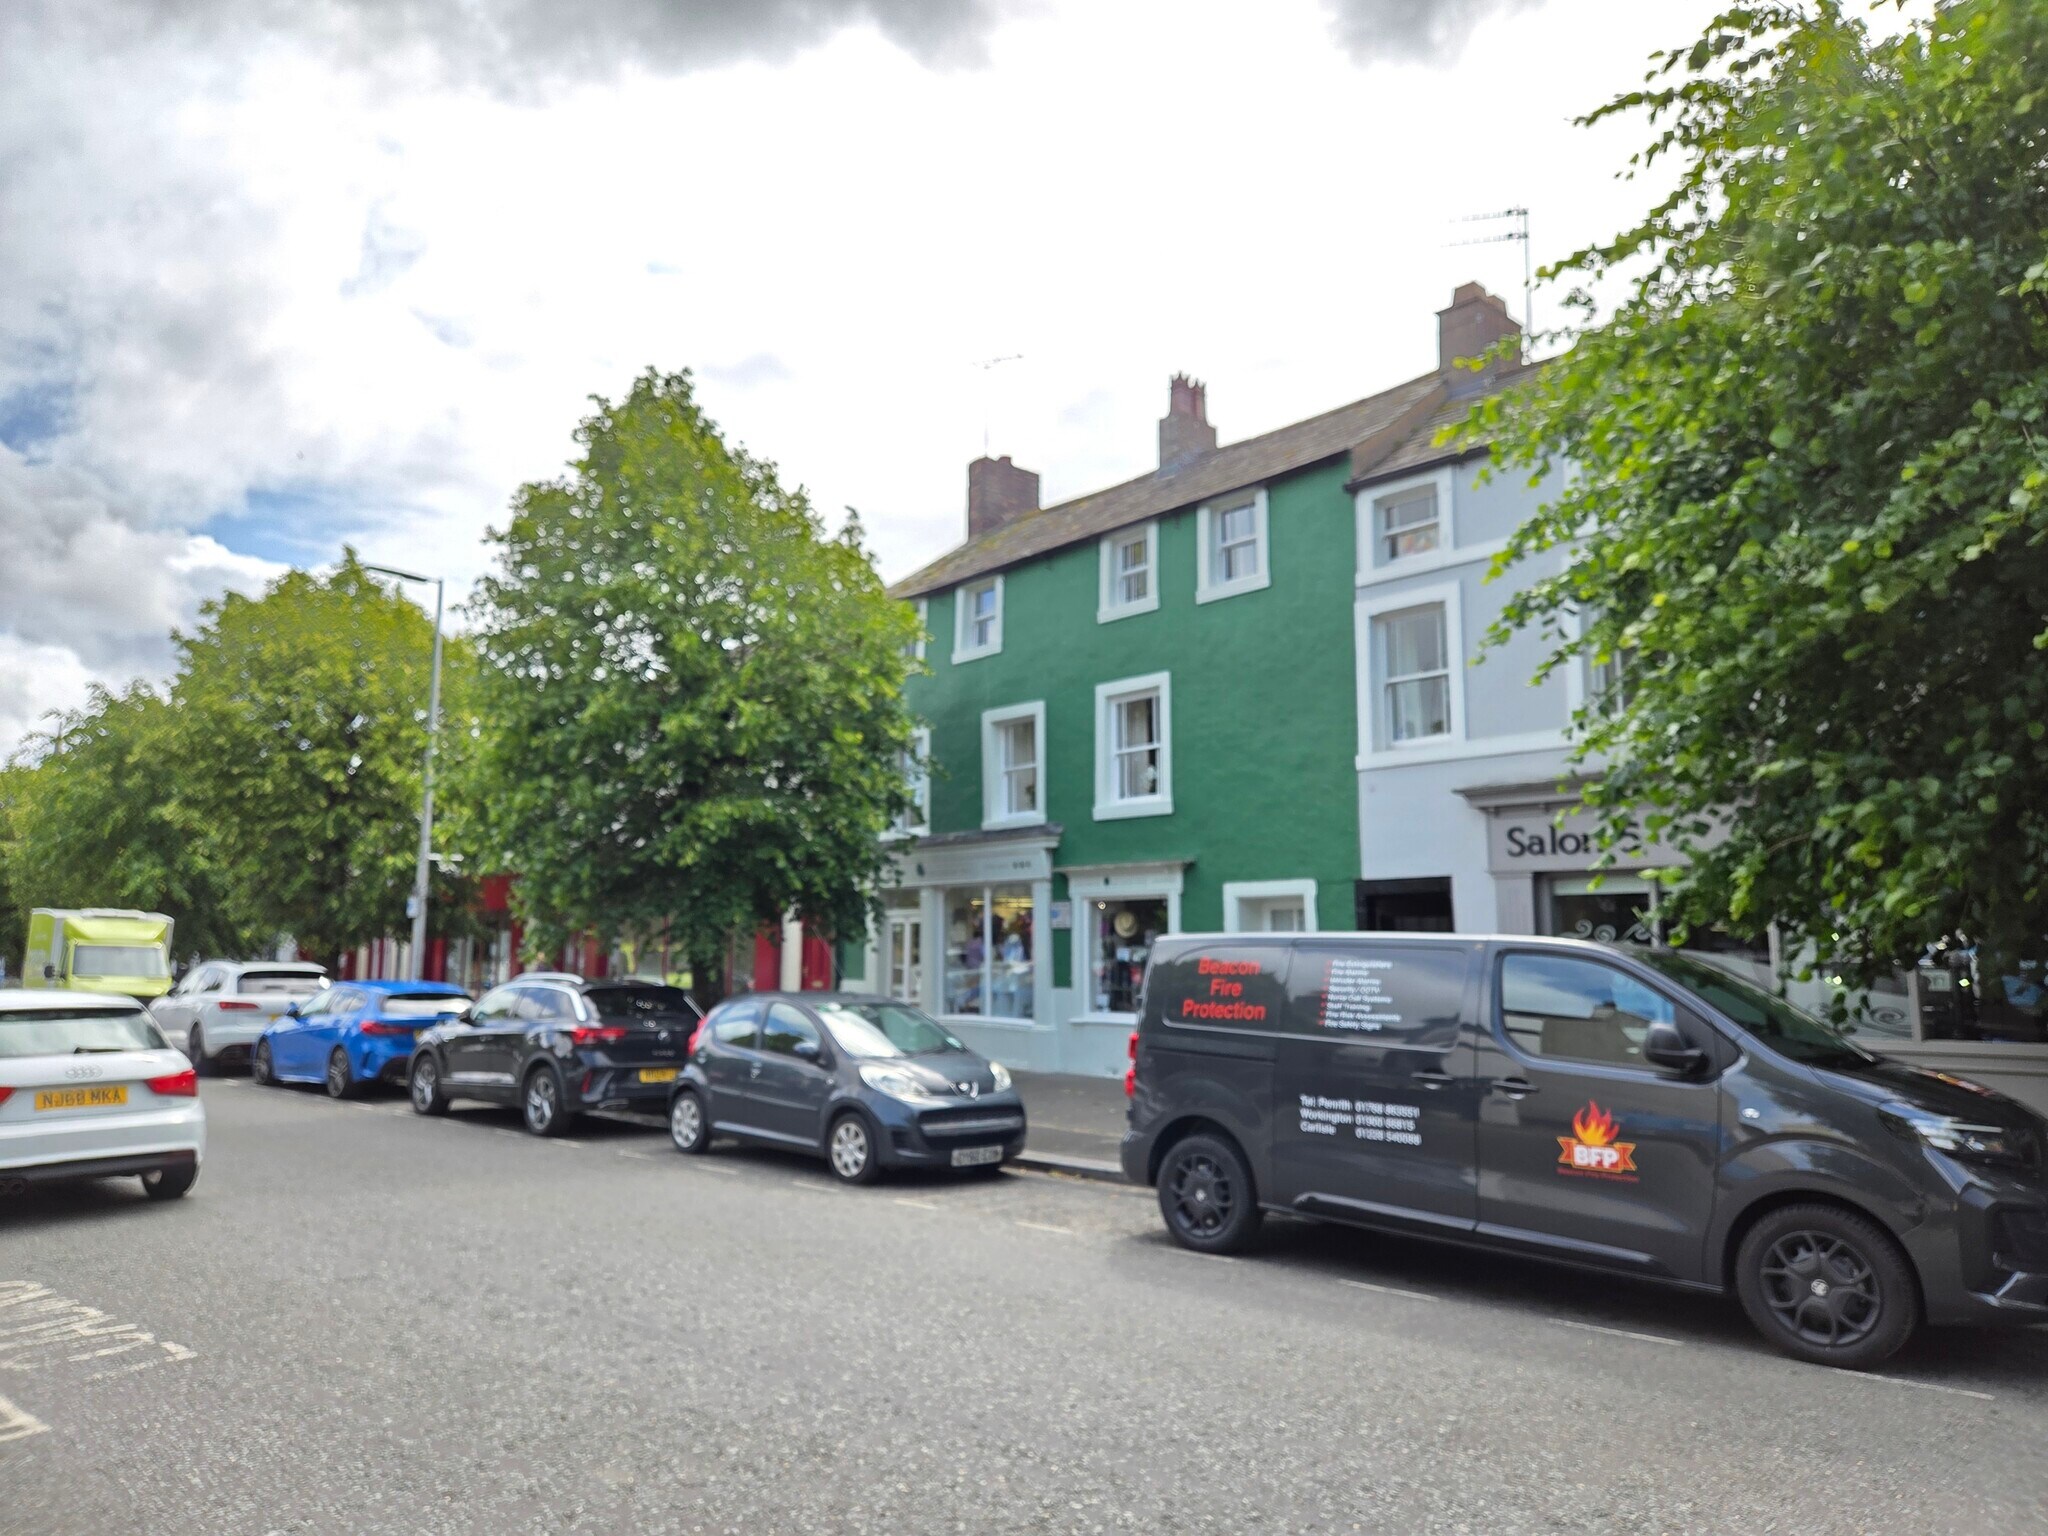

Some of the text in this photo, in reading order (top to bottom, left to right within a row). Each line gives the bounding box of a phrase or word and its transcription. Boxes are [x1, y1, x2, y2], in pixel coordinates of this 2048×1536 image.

[1198, 957, 1261, 976] Beacon
[1210, 978, 1243, 997] Fire
[1182, 996, 1266, 1020] Protection
[90, 1087, 121, 1104] MKA
[1300, 1107, 1354, 1125] Workington
[1300, 1120, 1337, 1135] Carlisle
[1574, 1144, 1620, 1168] BFP
